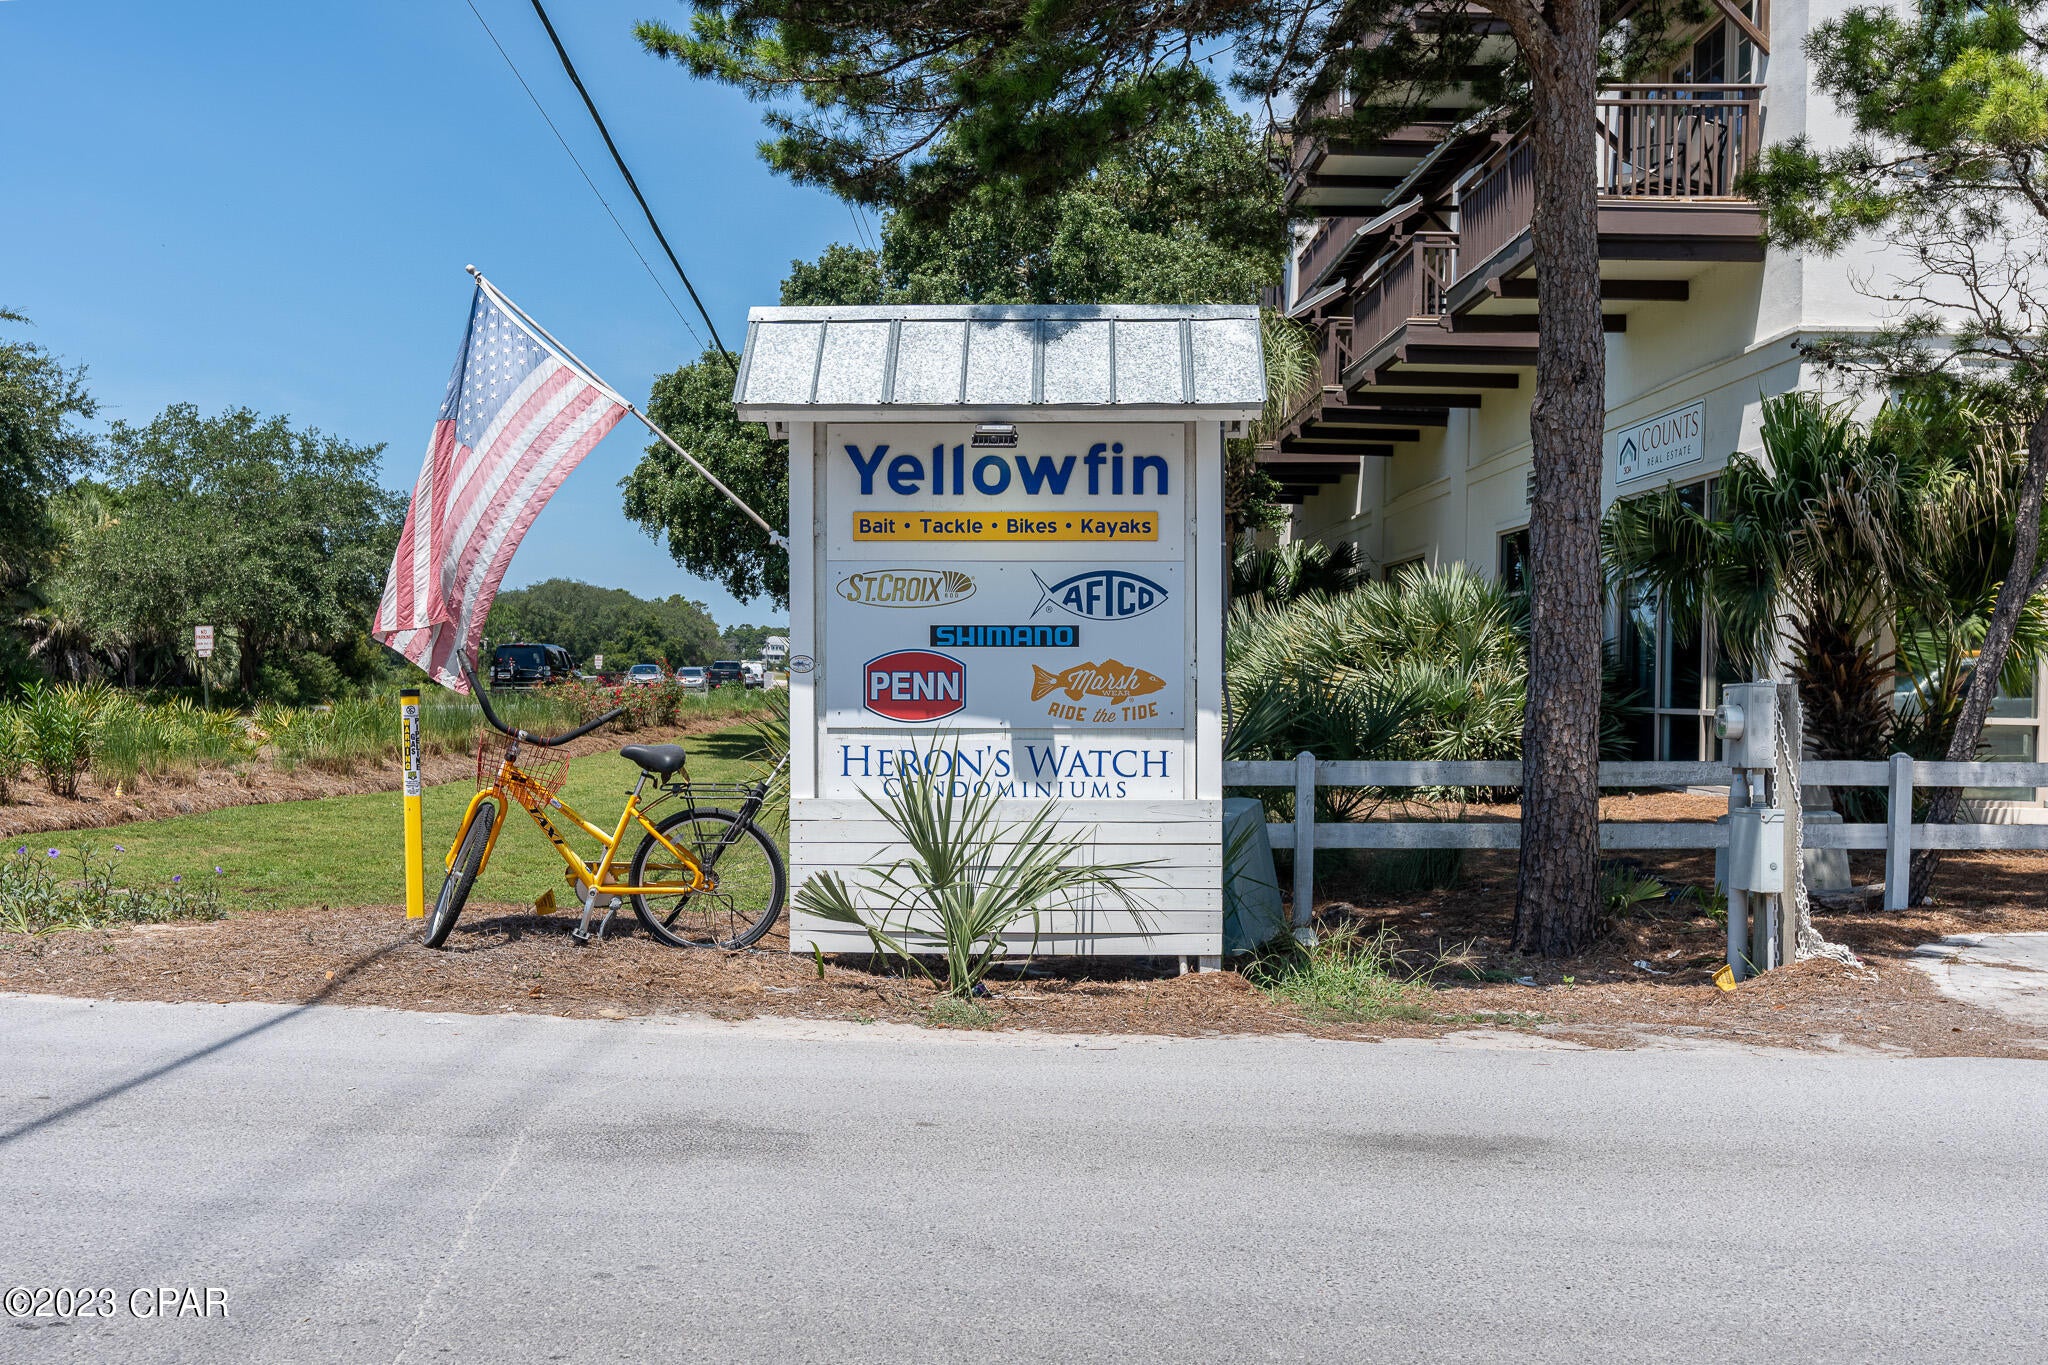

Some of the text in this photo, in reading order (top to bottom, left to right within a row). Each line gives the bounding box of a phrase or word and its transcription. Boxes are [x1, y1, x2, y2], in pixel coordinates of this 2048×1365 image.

[1641, 411, 1699, 452] COUNTS
[1647, 444, 1691, 467] REAL ESTATE
[844, 442, 1169, 496] Yellowfin
[859, 518, 1152, 538] Bait Tackle Bikes Kayaks
[936, 626, 1074, 646] SHIMANO
[870, 671, 960, 701] PENN
[1067, 667, 1141, 691] Marsh
[1048, 702, 1159, 723] RIDE the TIDE
[840, 745, 1170, 778] HERON'S WATCH
[883, 777, 1127, 798] CNDOMINIUMS
